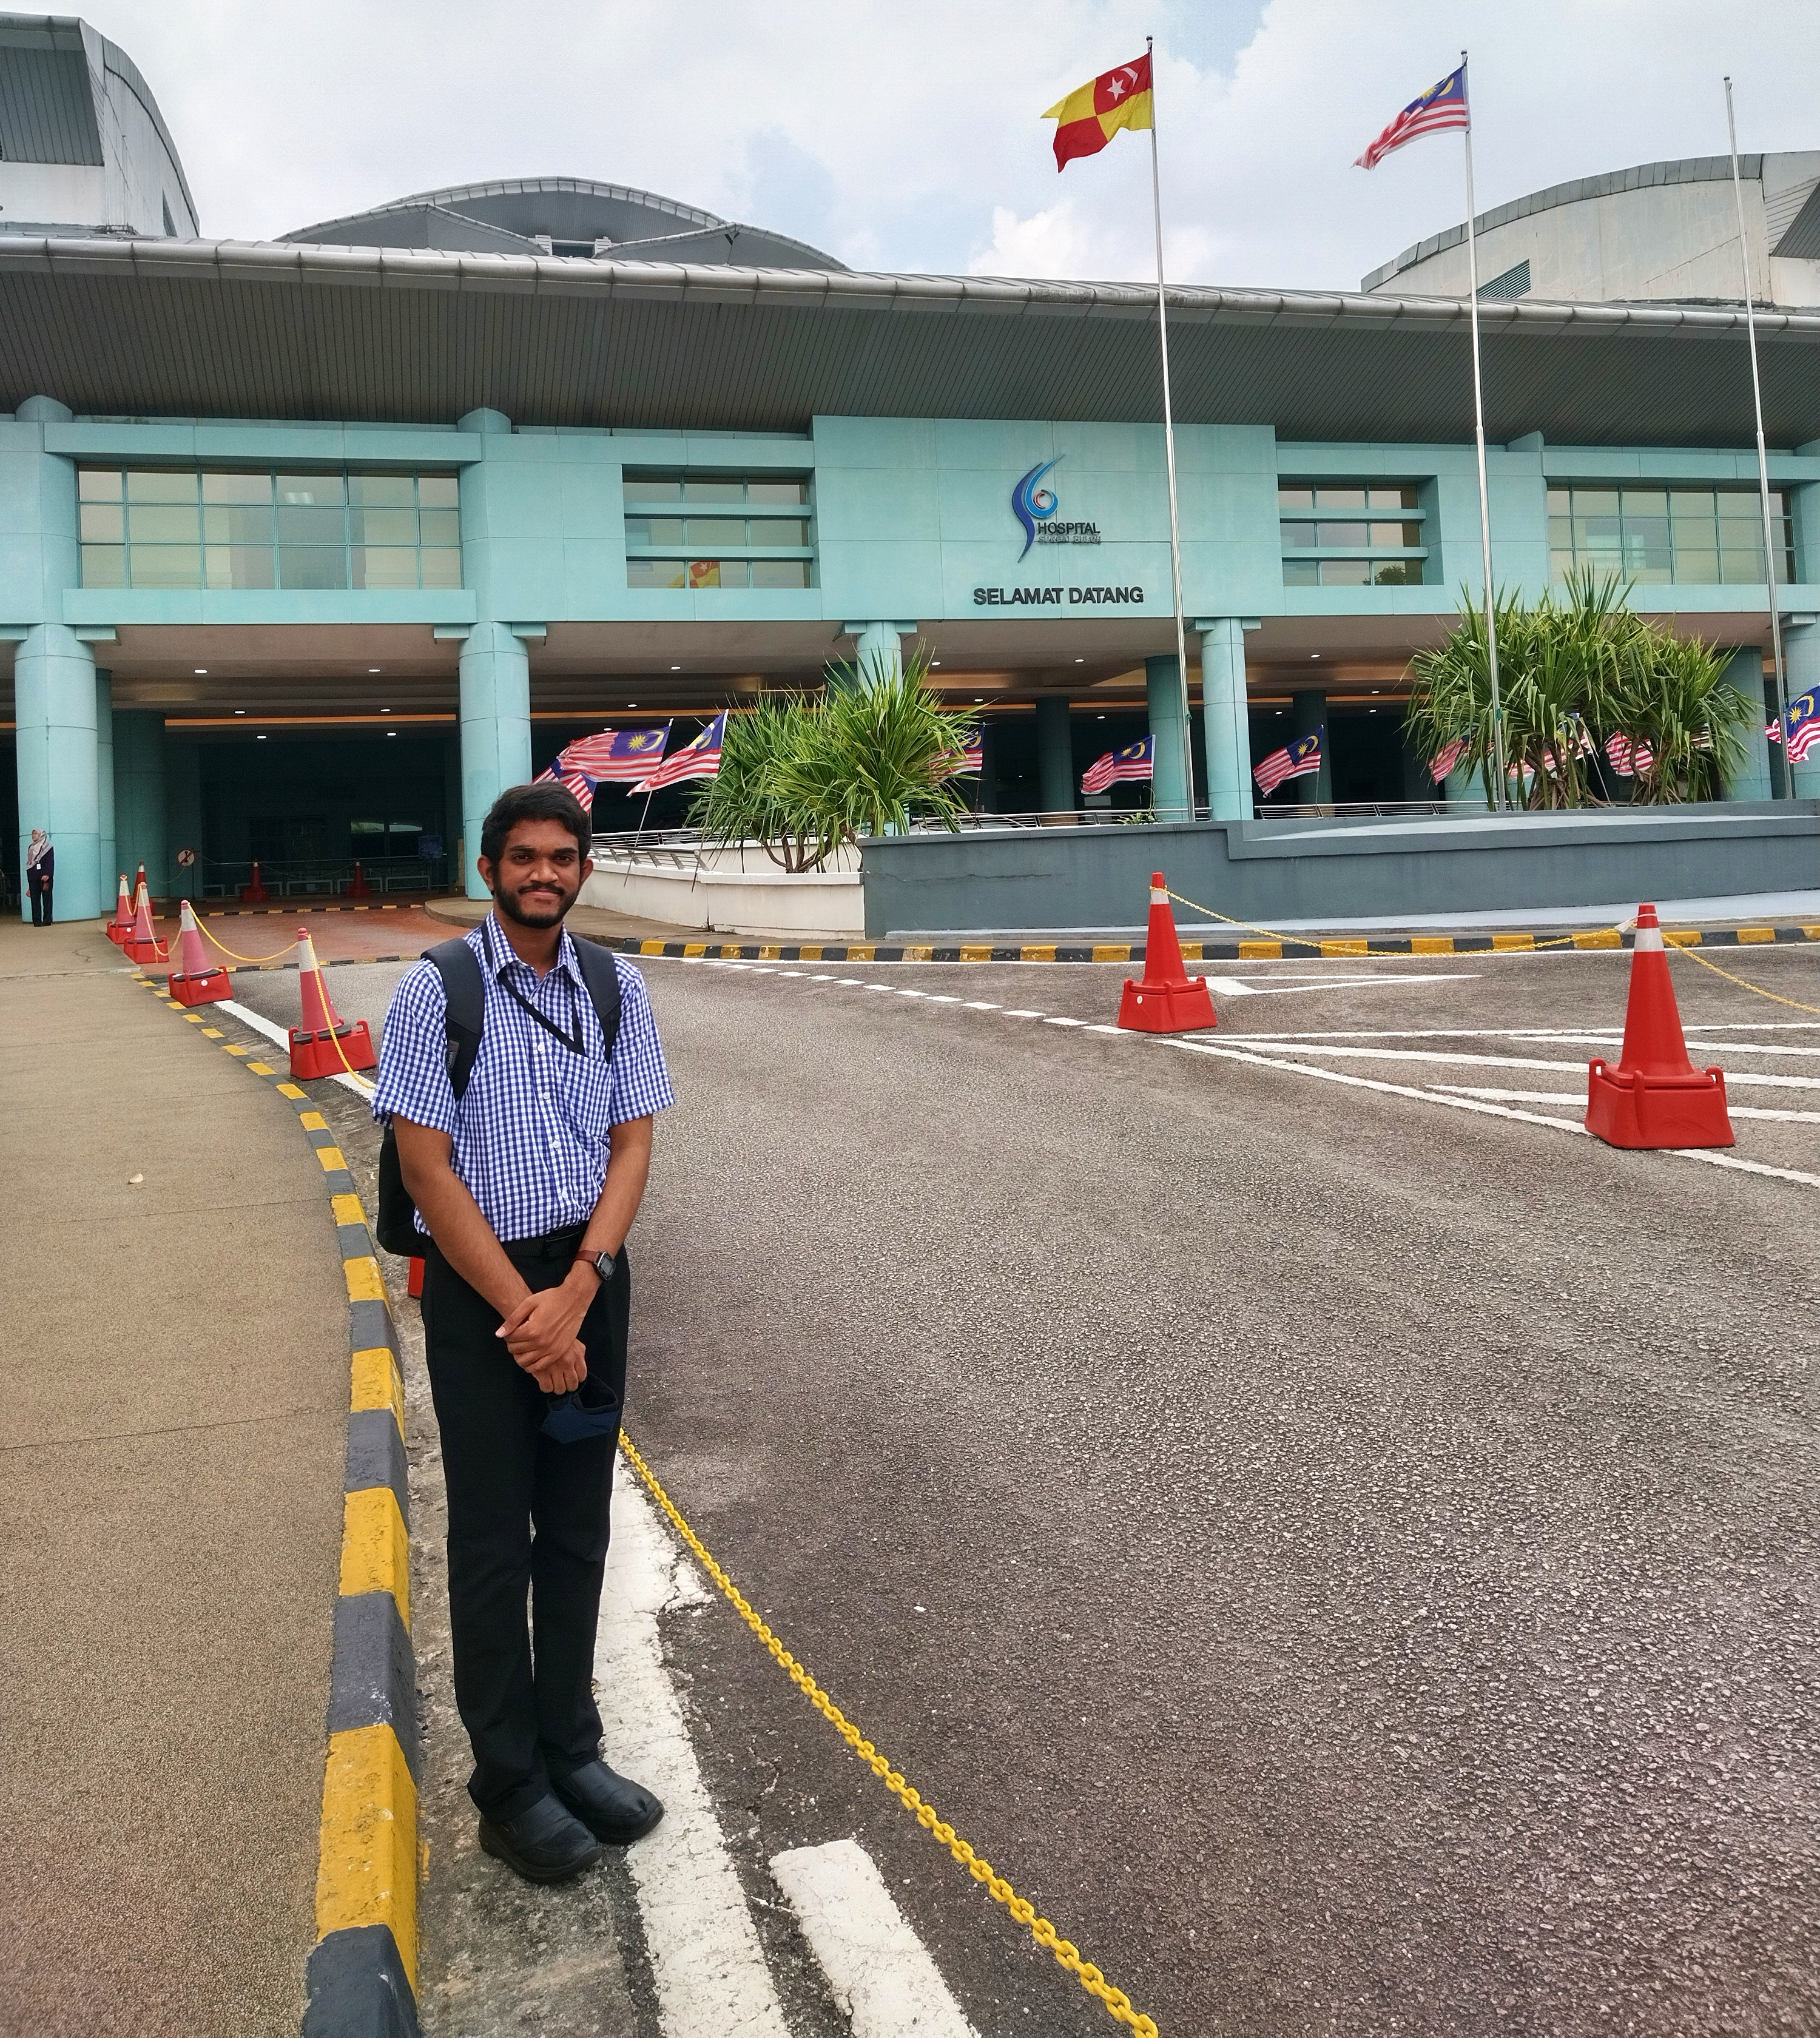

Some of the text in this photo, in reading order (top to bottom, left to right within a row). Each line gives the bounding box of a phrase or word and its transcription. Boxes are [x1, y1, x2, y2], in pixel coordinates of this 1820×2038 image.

[1037, 522, 1101, 534] HOSPITAL
[974, 587, 1144, 605] SELAMAT DATANG
